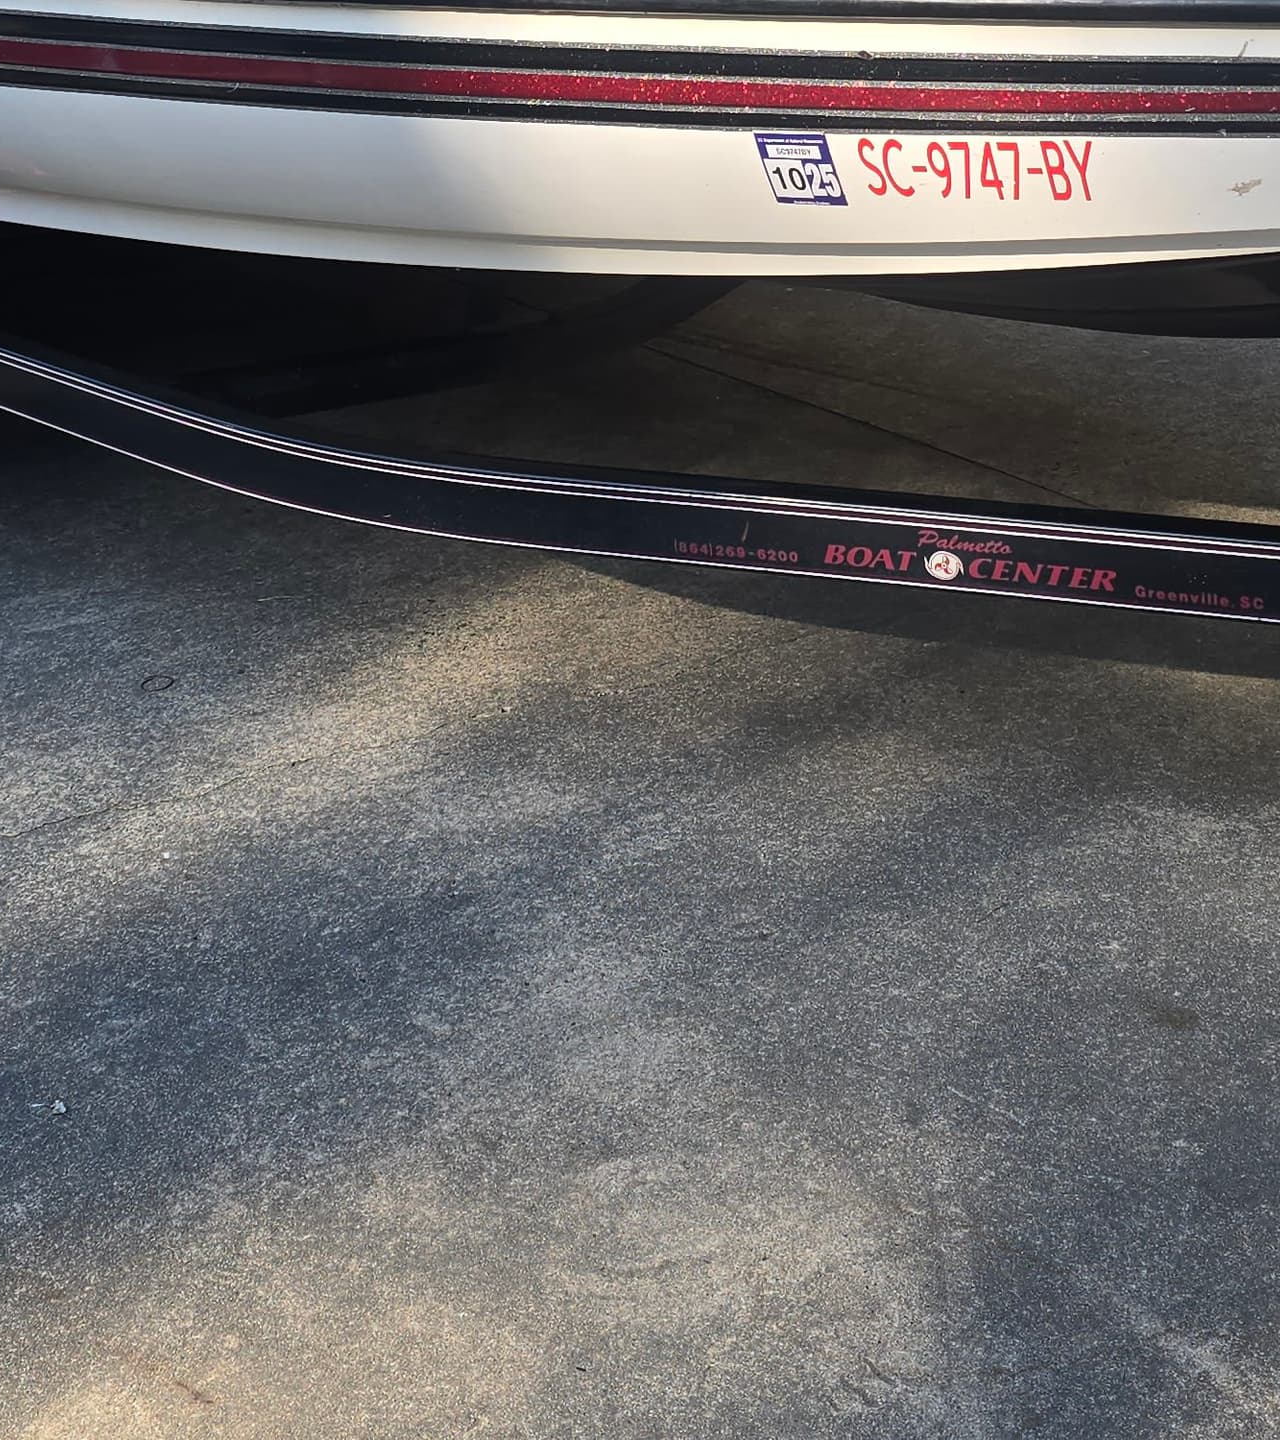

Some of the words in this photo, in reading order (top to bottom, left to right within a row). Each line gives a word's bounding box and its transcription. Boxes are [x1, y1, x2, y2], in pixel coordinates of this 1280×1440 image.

[771, 166, 807, 191] 10
[804, 163, 842, 198] 25
[857, 138, 1092, 201] SC-9747-BY
[917, 529, 1014, 555] Palmetto
[823, 543, 917, 572] BOAT
[969, 558, 1118, 592] CENTER
[1239, 595, 1265, 611] SC
